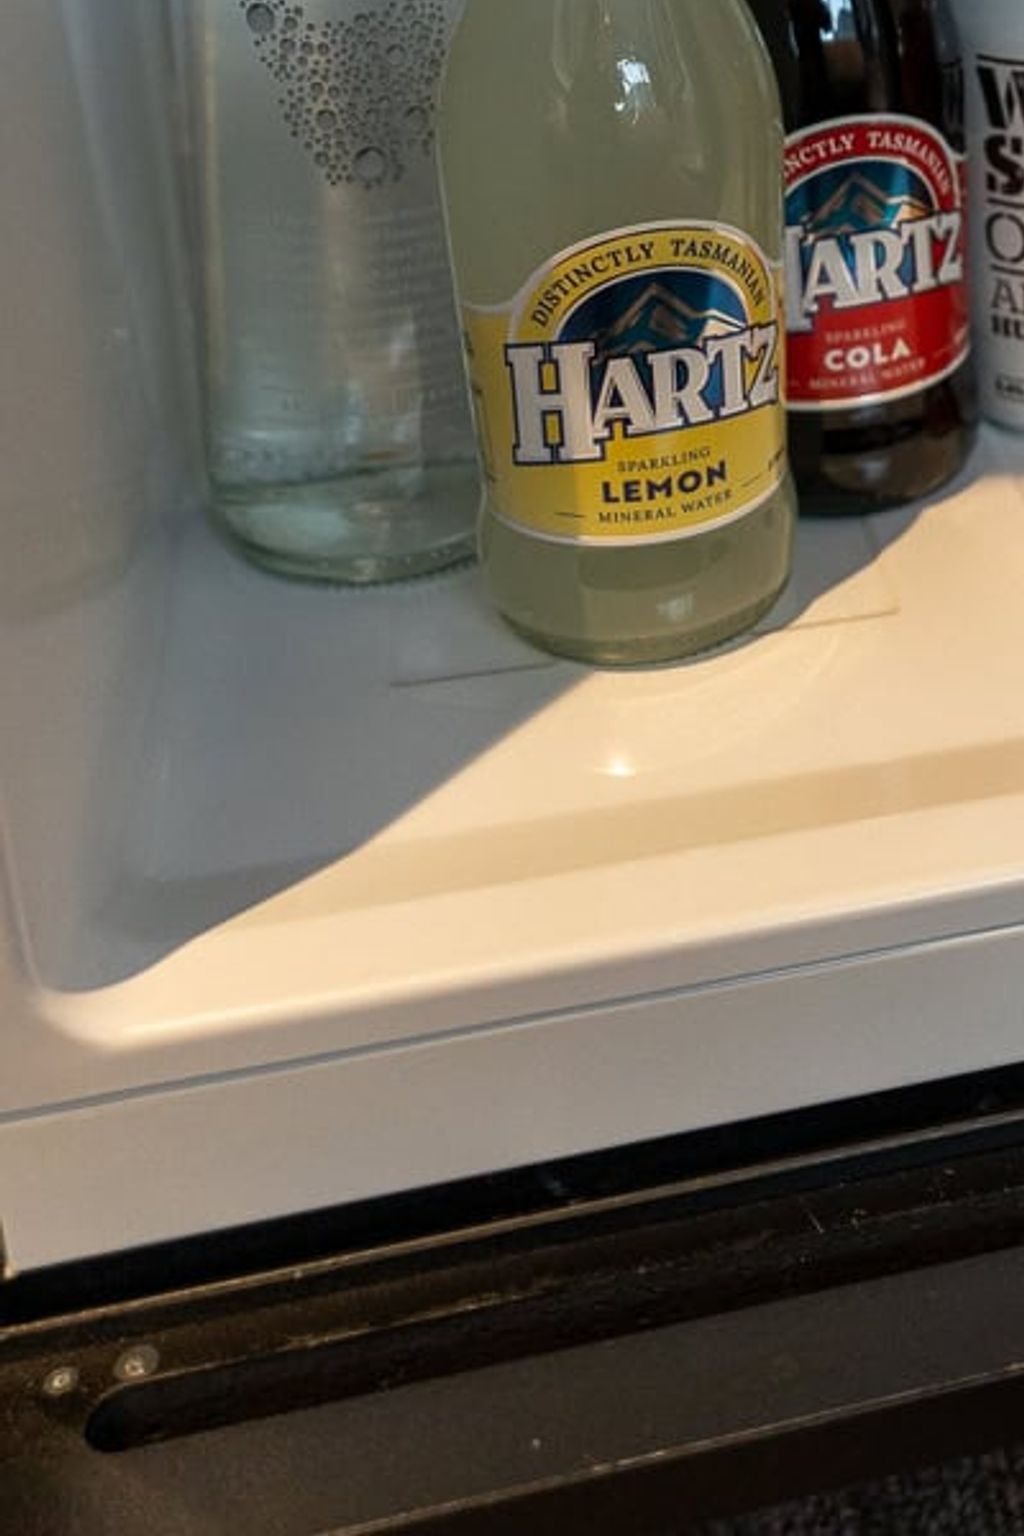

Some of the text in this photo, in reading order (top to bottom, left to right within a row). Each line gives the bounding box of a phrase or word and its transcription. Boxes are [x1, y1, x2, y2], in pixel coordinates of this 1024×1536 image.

[532, 238, 766, 329] DISTINCTLY TASMANIAN
[824, 337, 911, 371] COLA
[505, 321, 780, 466] HARTZ
[617, 445, 711, 472] SPARKLING
[602, 459, 727, 503] LEMON
[598, 489, 732, 524] MINERAL WATER
